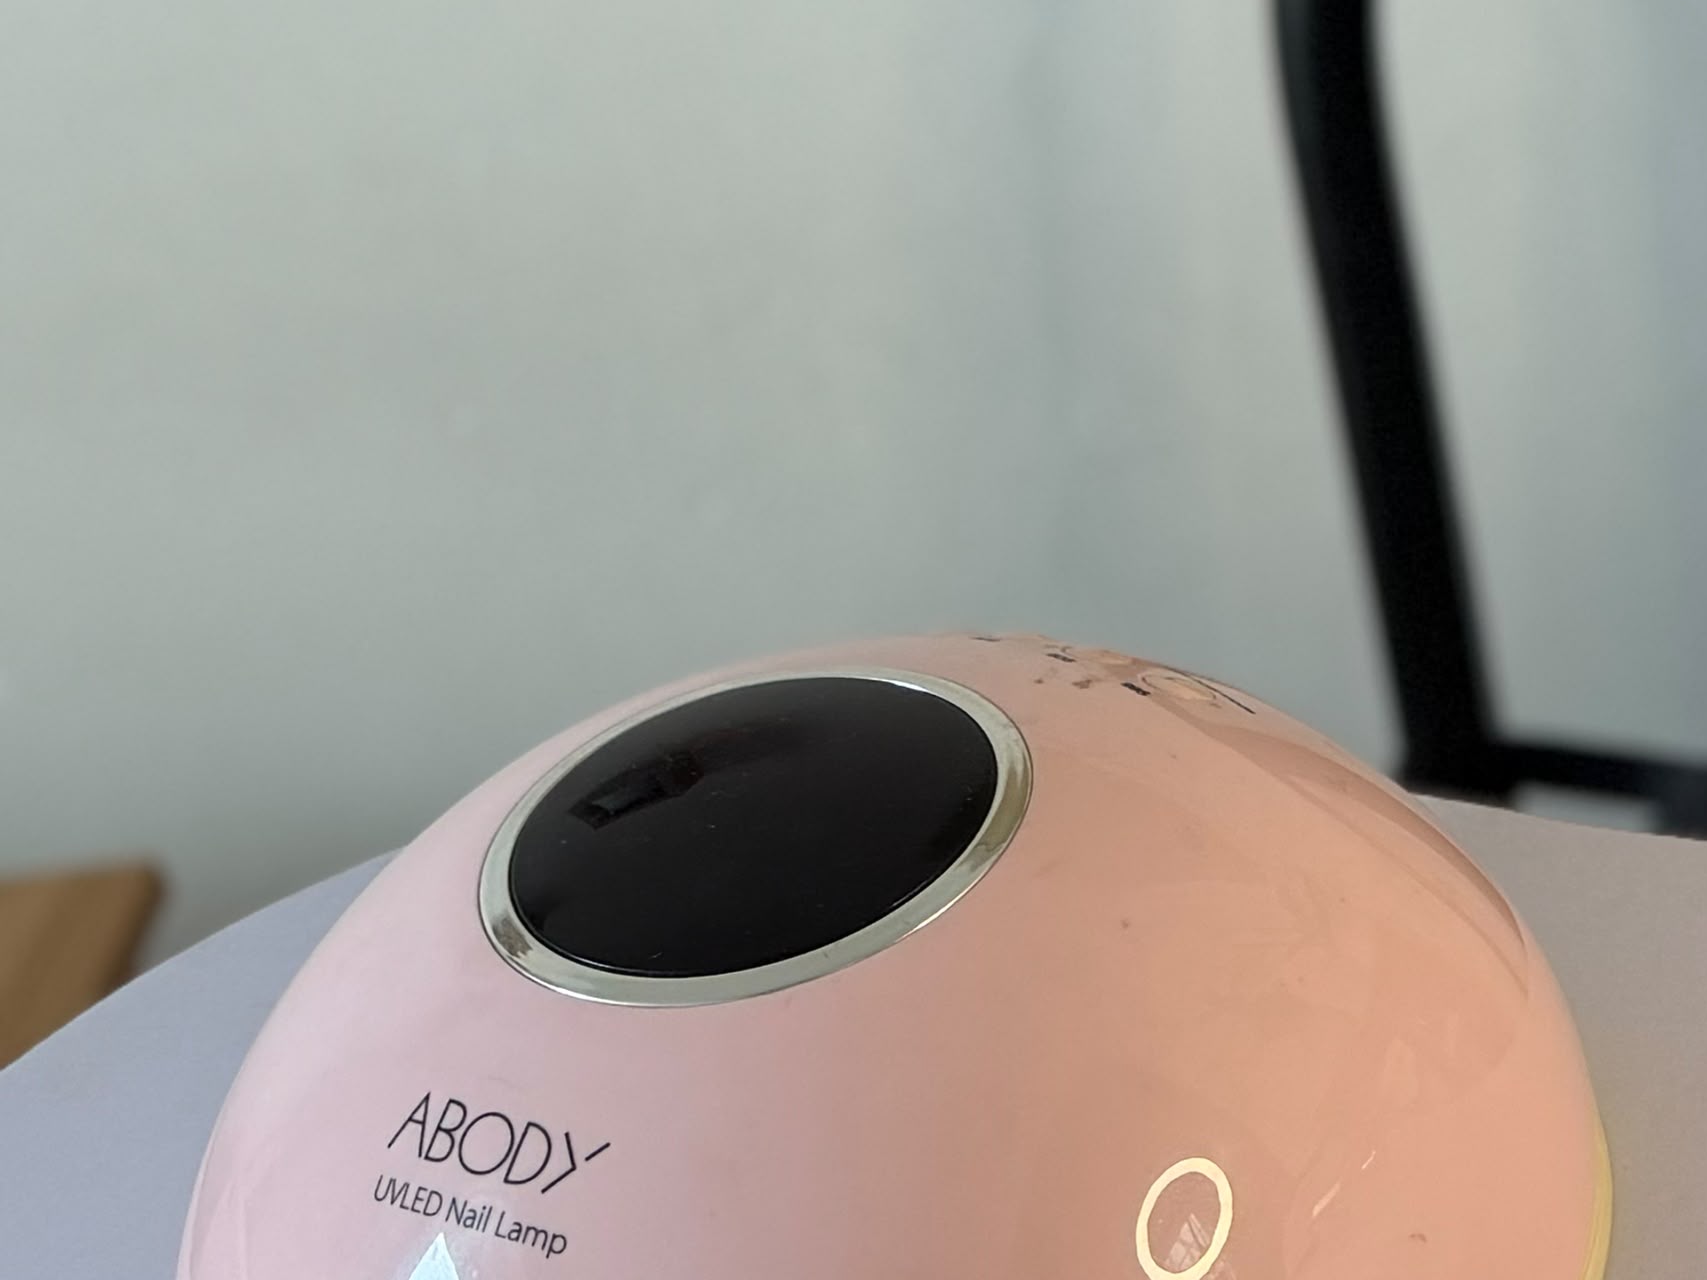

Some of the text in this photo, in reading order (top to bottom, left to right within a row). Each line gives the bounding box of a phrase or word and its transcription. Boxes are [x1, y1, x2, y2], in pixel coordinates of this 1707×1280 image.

[387, 1090, 611, 1194] ABODY
[445, 1196, 493, 1233] Nail
[494, 1210, 568, 1260] Lamp
